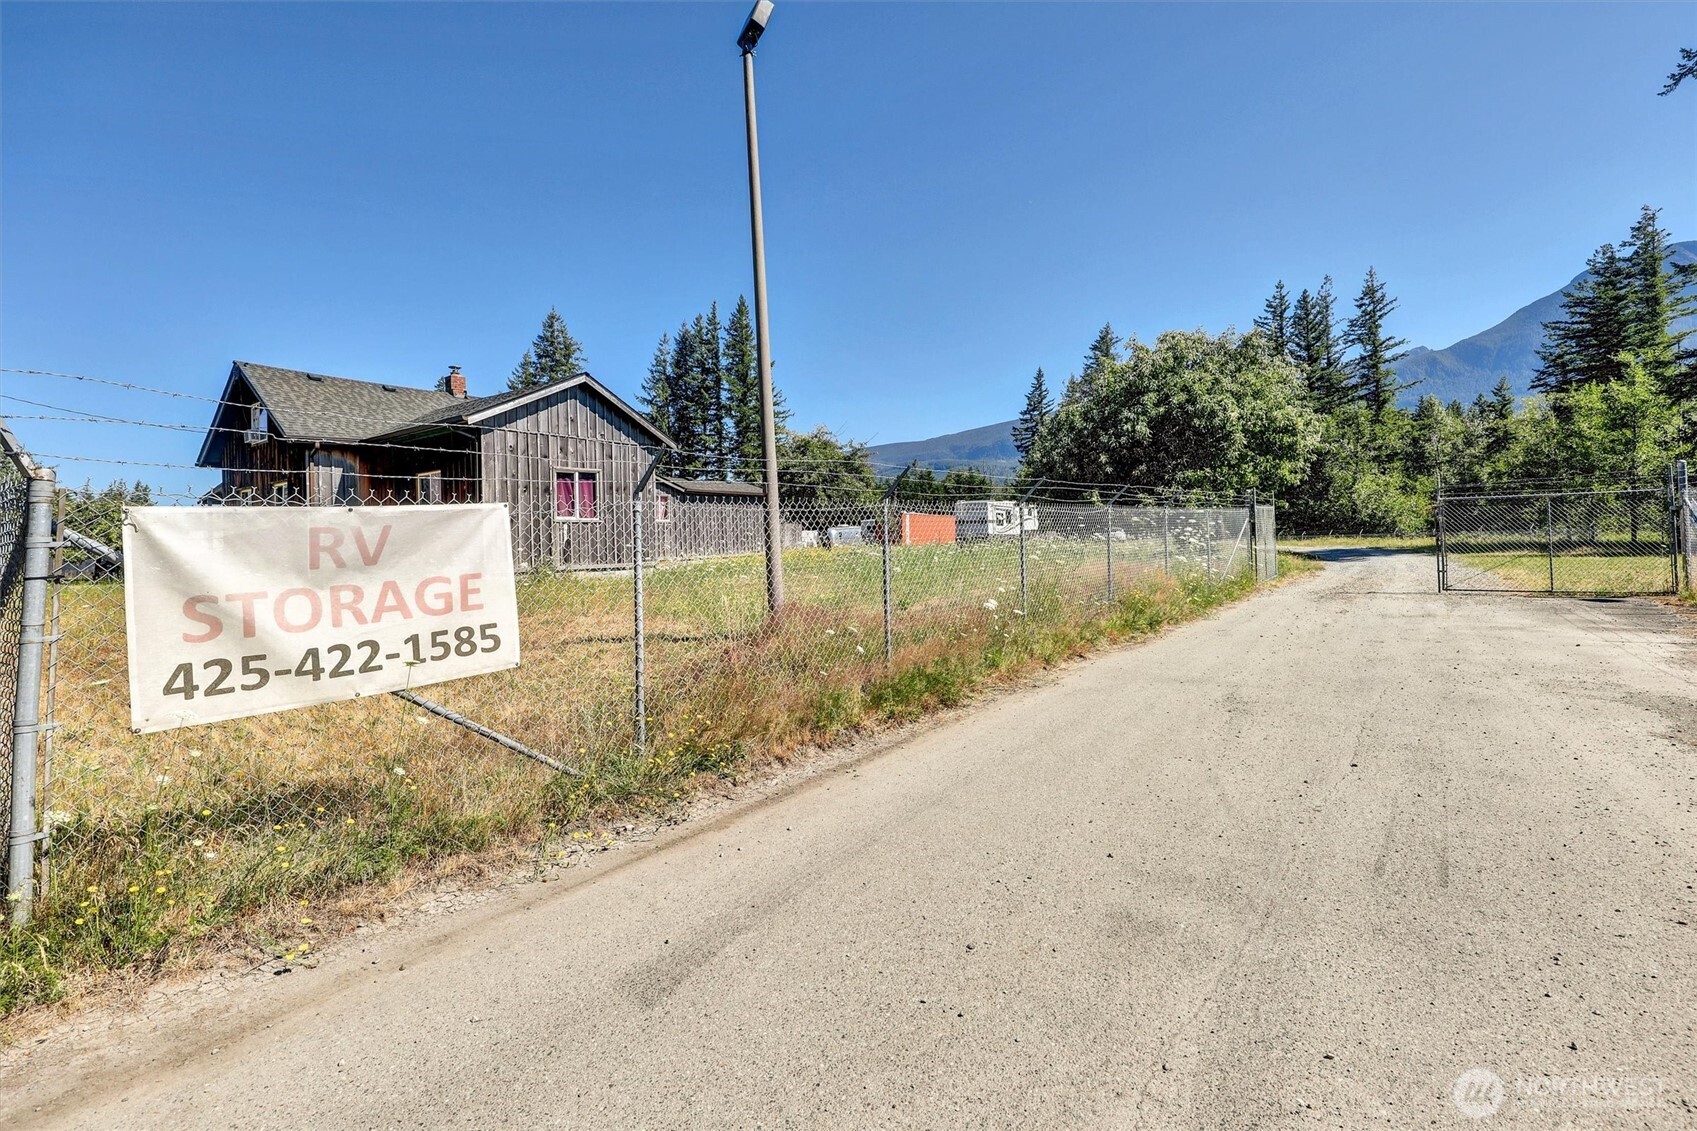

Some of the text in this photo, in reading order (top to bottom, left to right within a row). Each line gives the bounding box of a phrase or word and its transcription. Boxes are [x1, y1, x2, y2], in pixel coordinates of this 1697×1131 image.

[308, 524, 393, 570] RV
[181, 572, 485, 644] STORAGE
[162, 622, 502, 701] 425-422-1585
